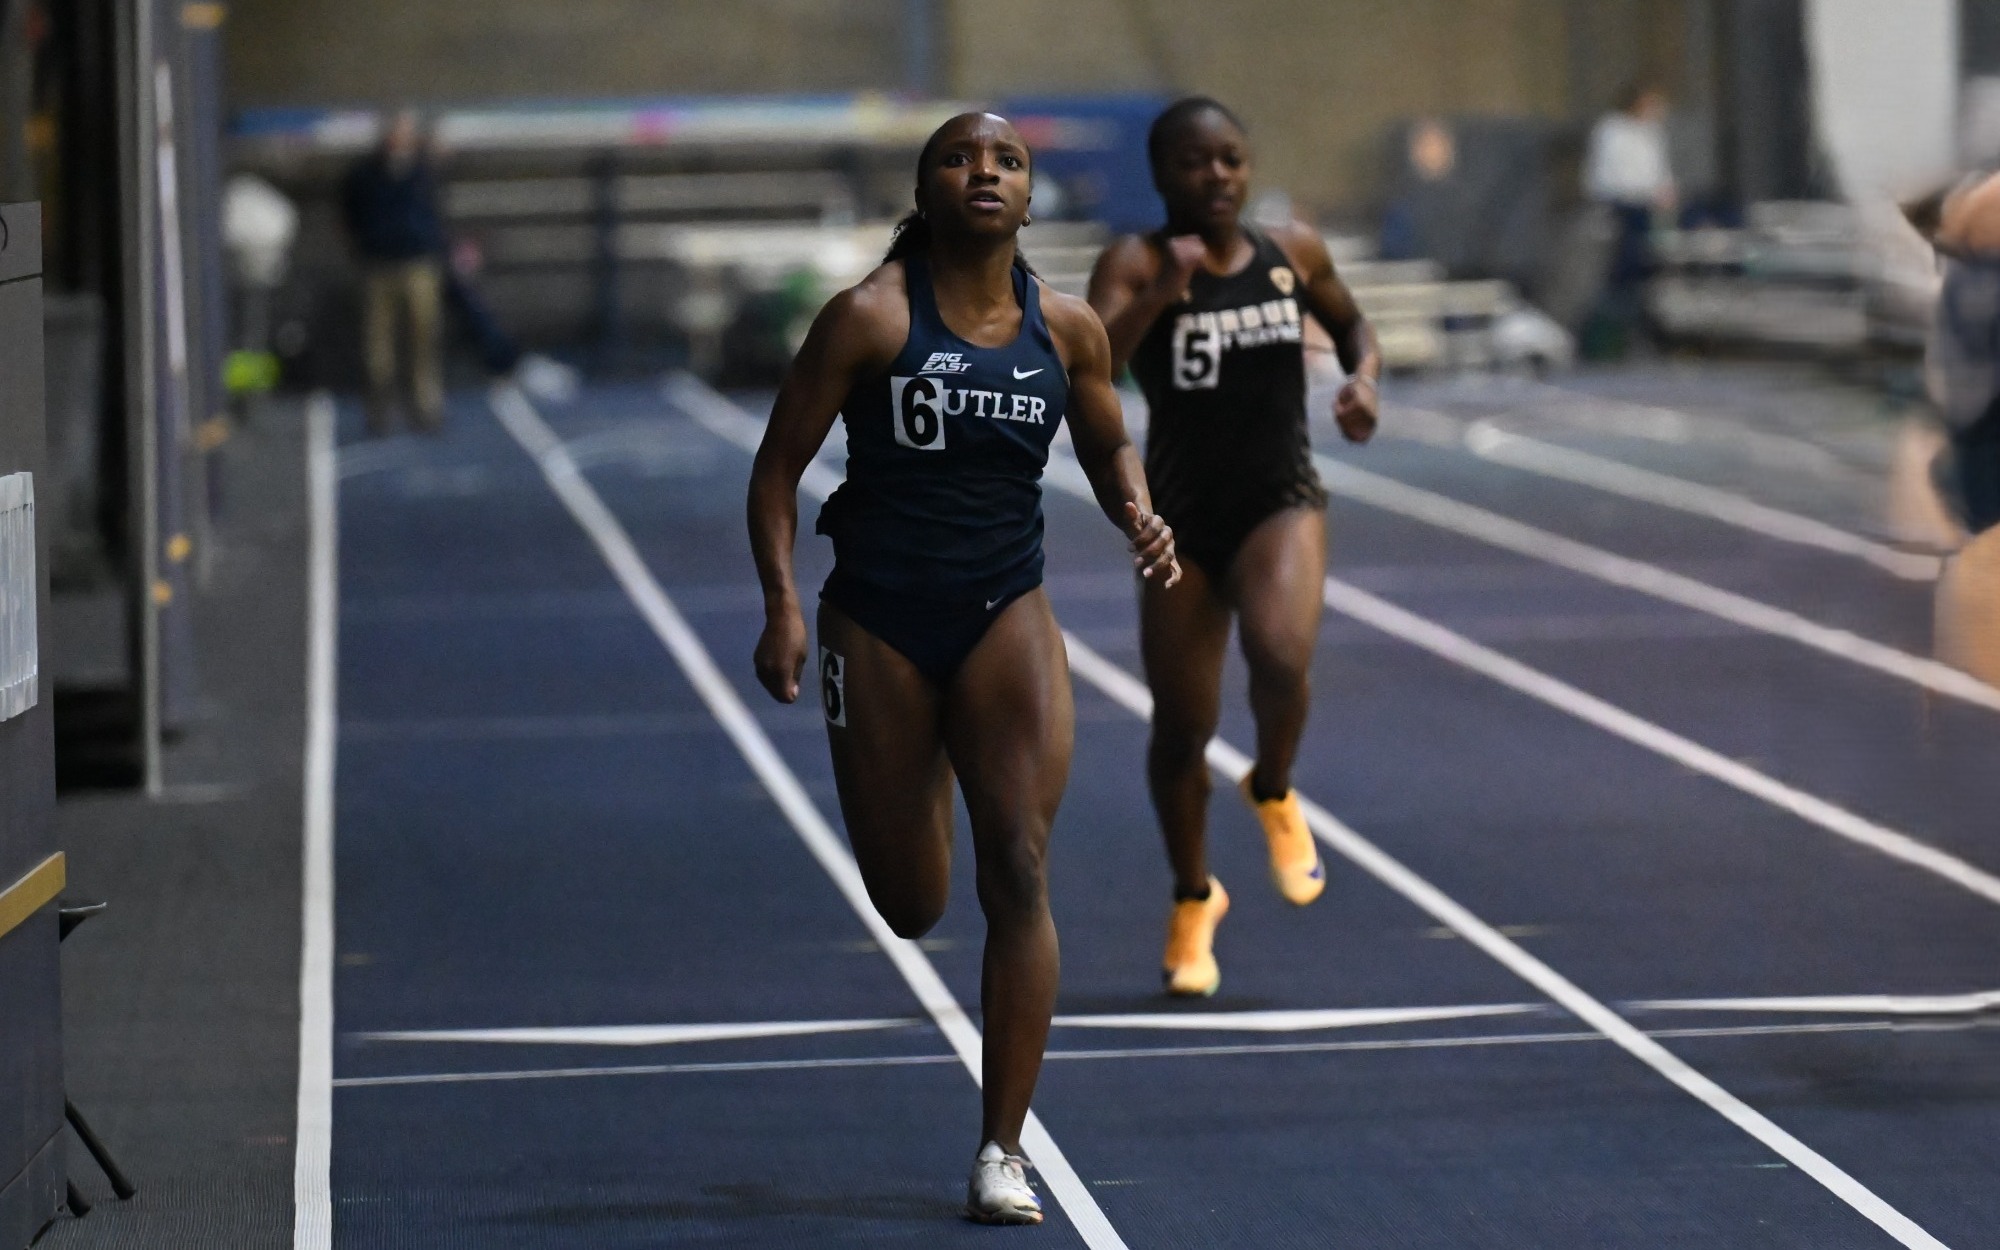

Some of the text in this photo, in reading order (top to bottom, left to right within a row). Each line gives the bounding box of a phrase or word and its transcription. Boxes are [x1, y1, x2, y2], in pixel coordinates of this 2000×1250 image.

[921, 362, 972, 372] EAST
[927, 352, 963, 362] BIG
[1181, 331, 1213, 382] 5
[901, 377, 939, 447] 6
[942, 388, 1046, 425] UTLER
[822, 652, 840, 720] 6
